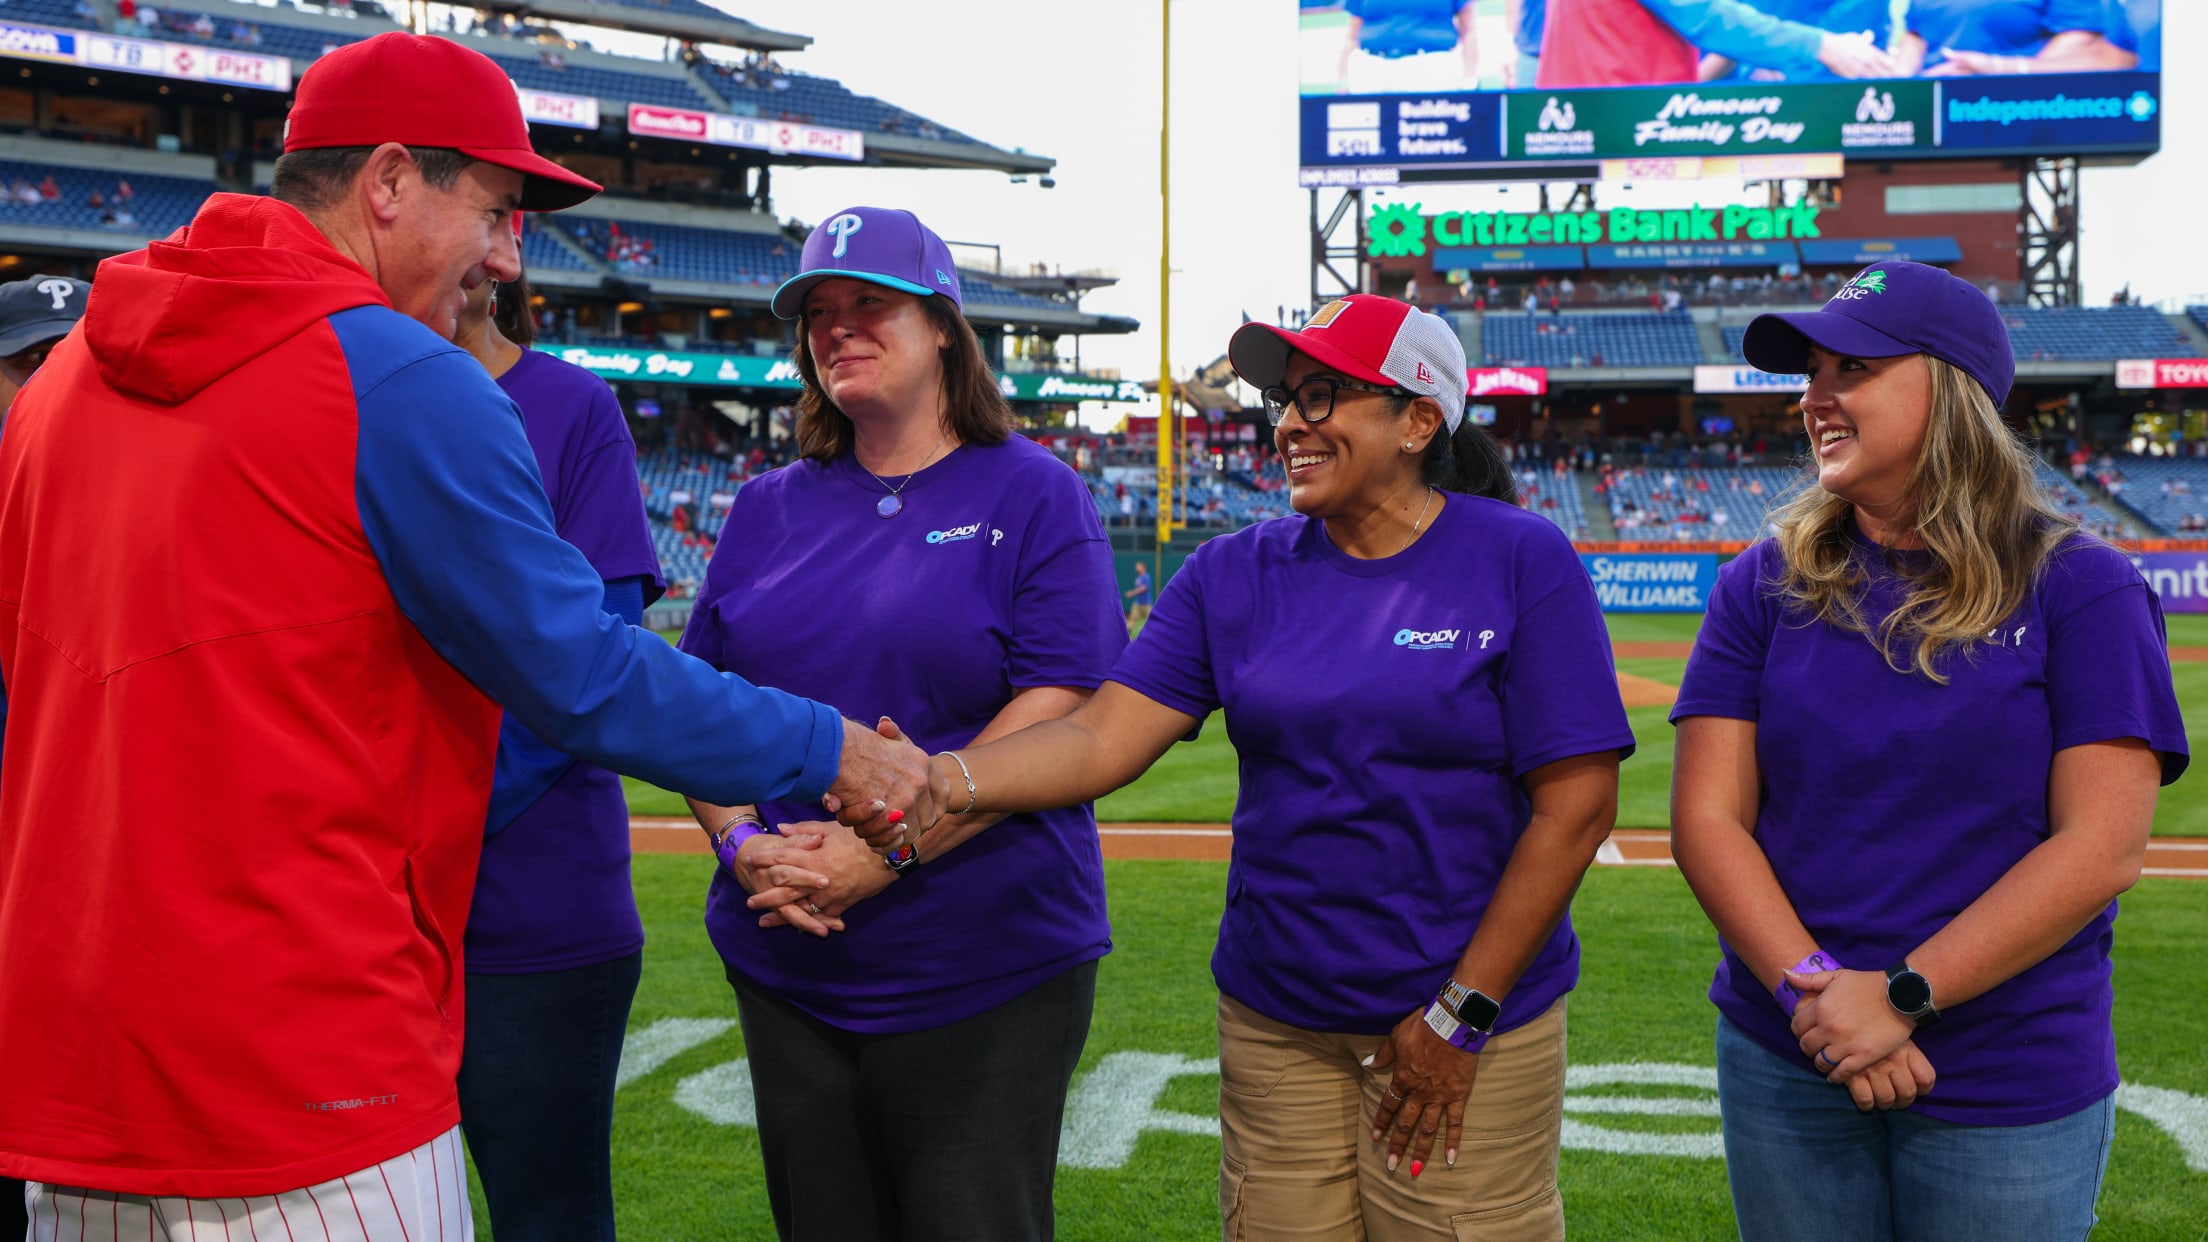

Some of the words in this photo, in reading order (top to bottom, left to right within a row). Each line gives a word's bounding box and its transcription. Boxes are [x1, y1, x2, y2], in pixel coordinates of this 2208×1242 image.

[216, 56, 264, 82] PHI
[1399, 99, 1471, 122] Building
[1656, 93, 1783, 120] Nemours
[1949, 93, 2123, 126] Independence
[1399, 119, 1448, 137] brave
[1634, 119, 1735, 146] Family
[1740, 117, 1805, 143] Day
[808, 131, 843, 152] PHI
[1432, 210, 1602, 246] Citizens
[1609, 202, 1718, 242] Bank
[1722, 196, 1820, 240] Park
[827, 213, 863, 259] P
[37, 279, 74, 310] P
[562, 348, 641, 374] Family
[646, 354, 693, 376] Day
[1591, 557, 1698, 582] SHERWIN
[1410, 629, 1460, 644] PCADV
[1478, 629, 1495, 649] P
[304, 1094, 398, 1111] THERMA-FIT
